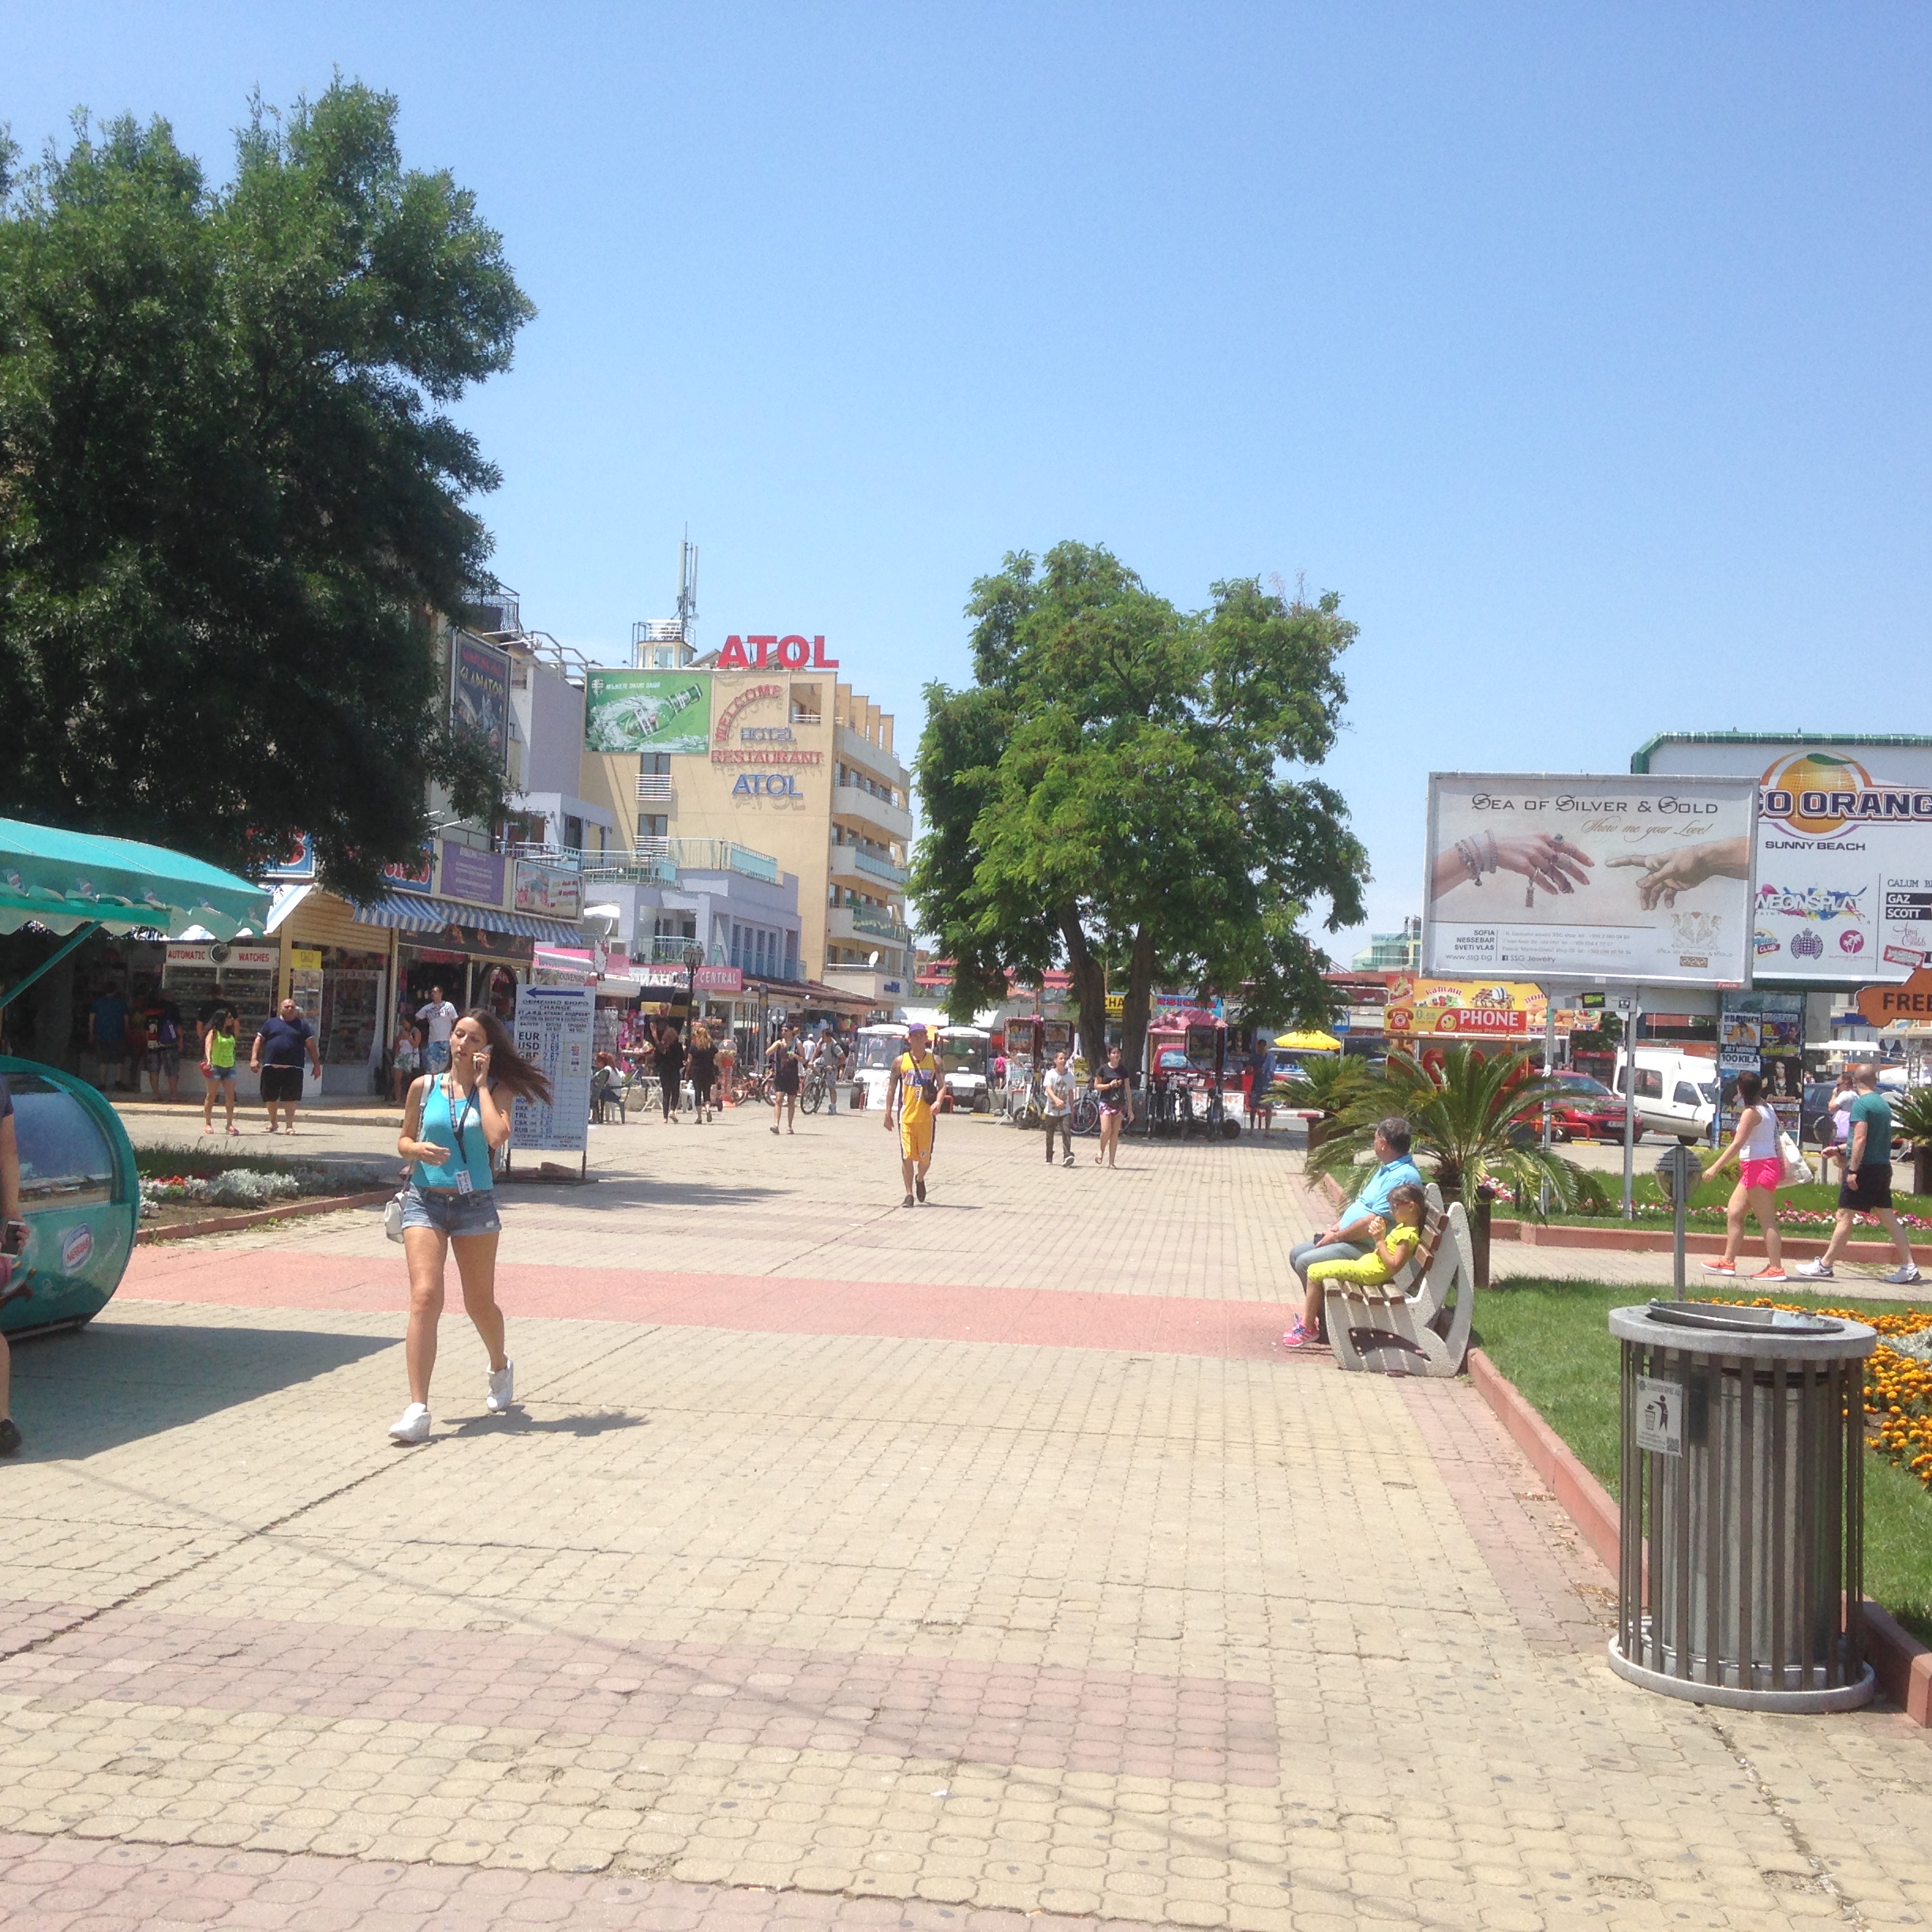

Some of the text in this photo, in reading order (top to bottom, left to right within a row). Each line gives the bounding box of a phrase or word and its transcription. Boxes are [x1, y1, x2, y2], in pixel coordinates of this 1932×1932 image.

[716, 635, 839, 668] ATOL
[715, 683, 783, 743] WELCOME
[740, 726, 797, 742] HOTEL
[711, 750, 822, 764] RESTAURANT
[732, 773, 803, 796] ATOL
[1471, 793, 1515, 811] SEA
[1525, 800, 1550, 811] OF
[1555, 795, 1627, 813] SILVER
[1638, 800, 1652, 813] &
[1759, 791, 1794, 817] O
[1623, 825, 1639, 833] me
[1765, 841, 1866, 851] SUNNY BEACH
[1887, 878, 1919, 888] CALUM
[1888, 894, 1910, 904] GAZ
[1887, 908, 1921, 919] SCOTT
[167, 949, 206, 960] AUTOMATIC
[238, 952, 270, 963] WATCHES
[700, 971, 736, 984] CENTRAL
[1459, 1009, 1519, 1026] PHONE
[519, 1032, 540, 1041] EUR
[518, 1042, 540, 1050] USD
